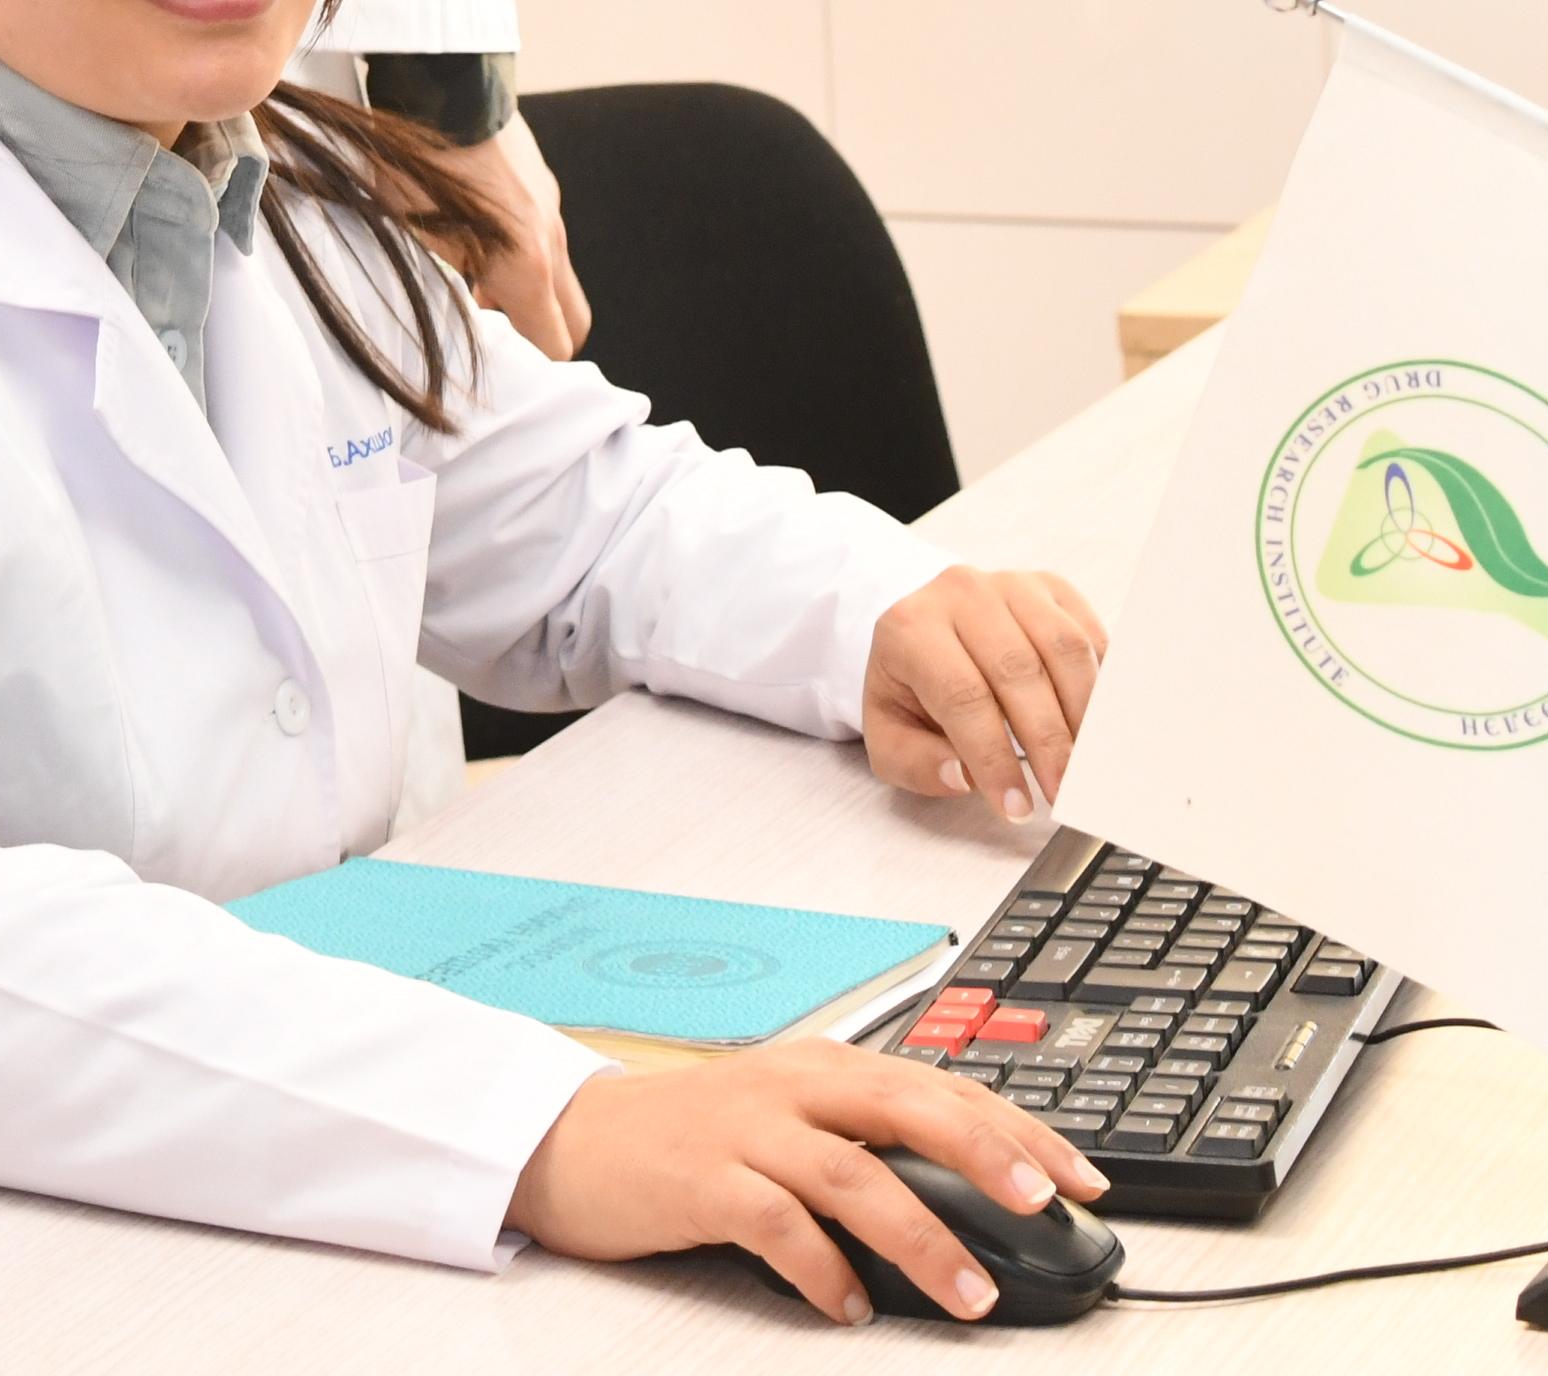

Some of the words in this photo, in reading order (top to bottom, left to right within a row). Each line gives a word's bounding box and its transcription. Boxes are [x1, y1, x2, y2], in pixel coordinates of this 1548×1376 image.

[1362, 368, 1443, 401] DRUG
[1265, 393, 1355, 525] RESEARCH
[1265, 538, 1351, 690] INSTITUTE
